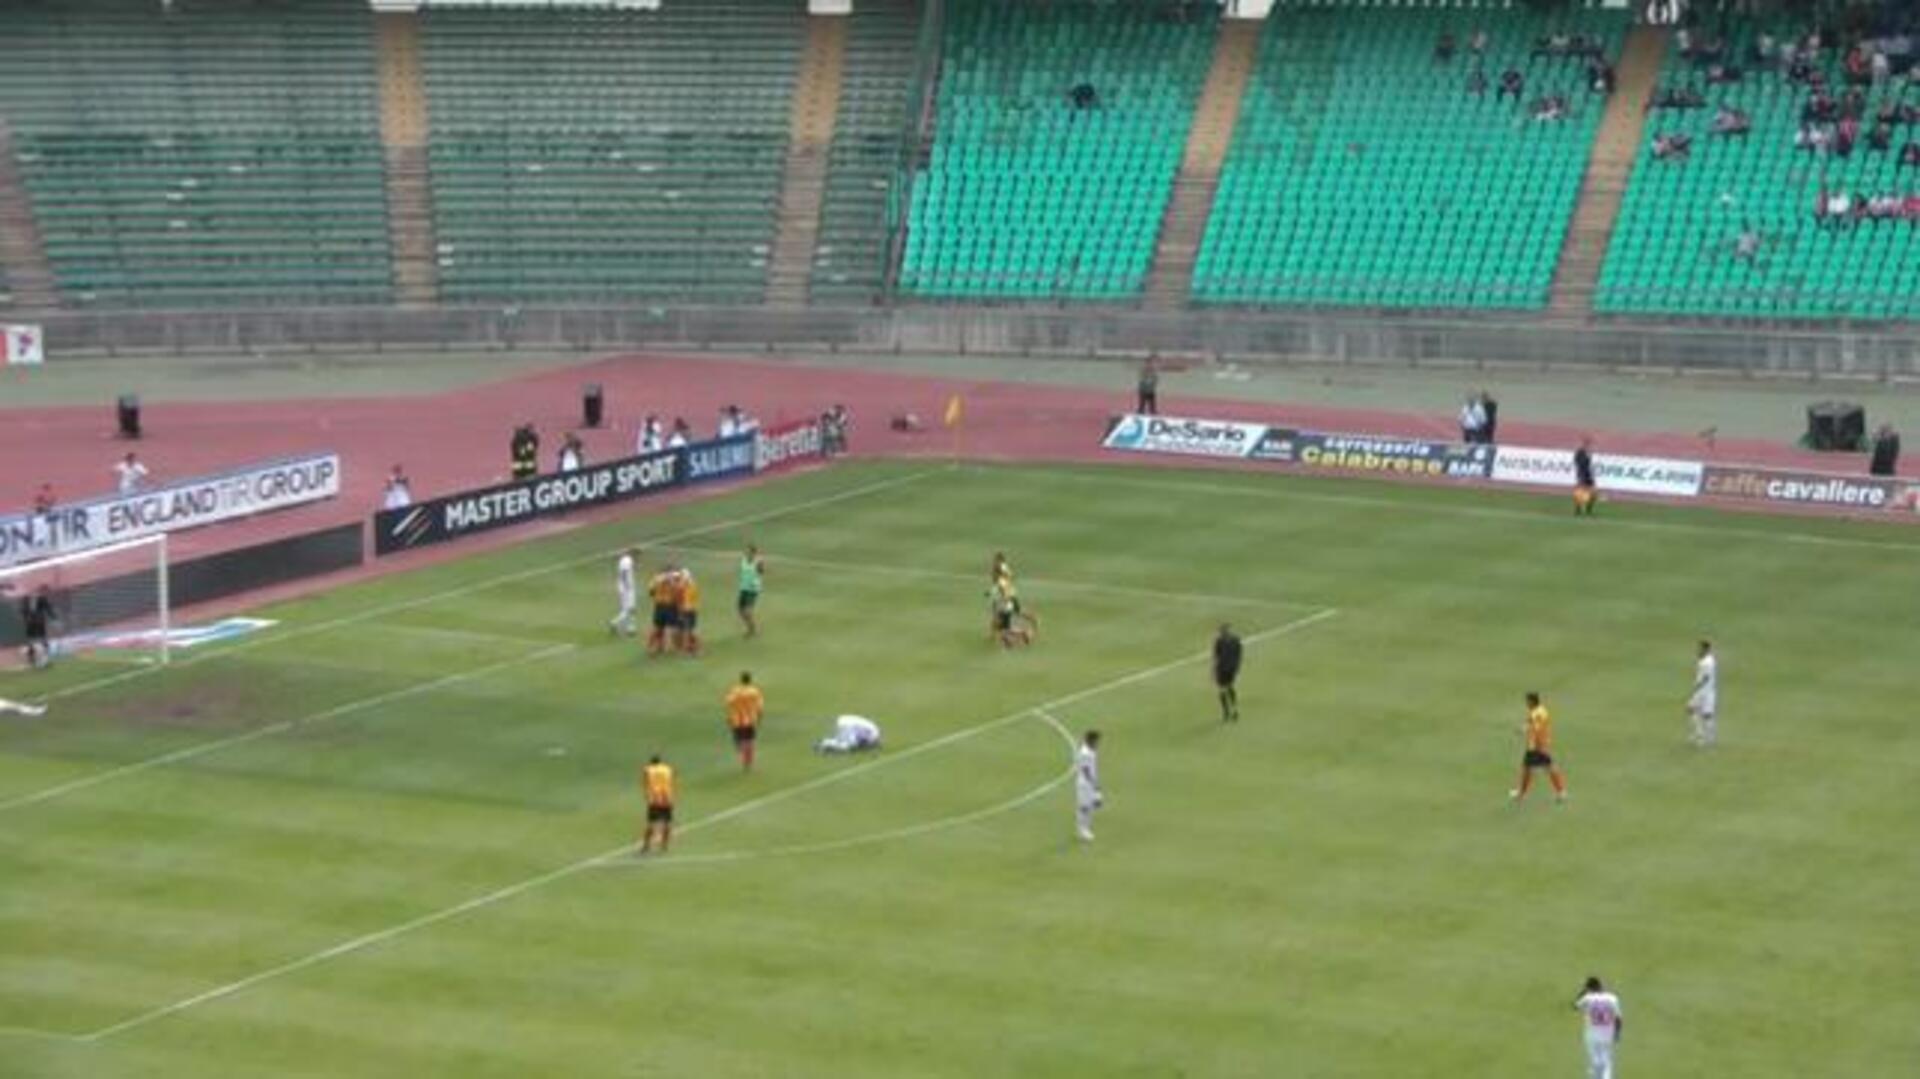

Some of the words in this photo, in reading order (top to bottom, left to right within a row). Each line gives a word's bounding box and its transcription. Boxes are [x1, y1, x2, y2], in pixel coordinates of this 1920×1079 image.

[1302, 445, 1443, 477] Calabrese
[1498, 454, 1573, 474] NISSAN
[256, 460, 336, 502] GROUP
[444, 489, 532, 530] MASTER
[534, 472, 613, 509] GROUP
[615, 453, 679, 493] SPORT
